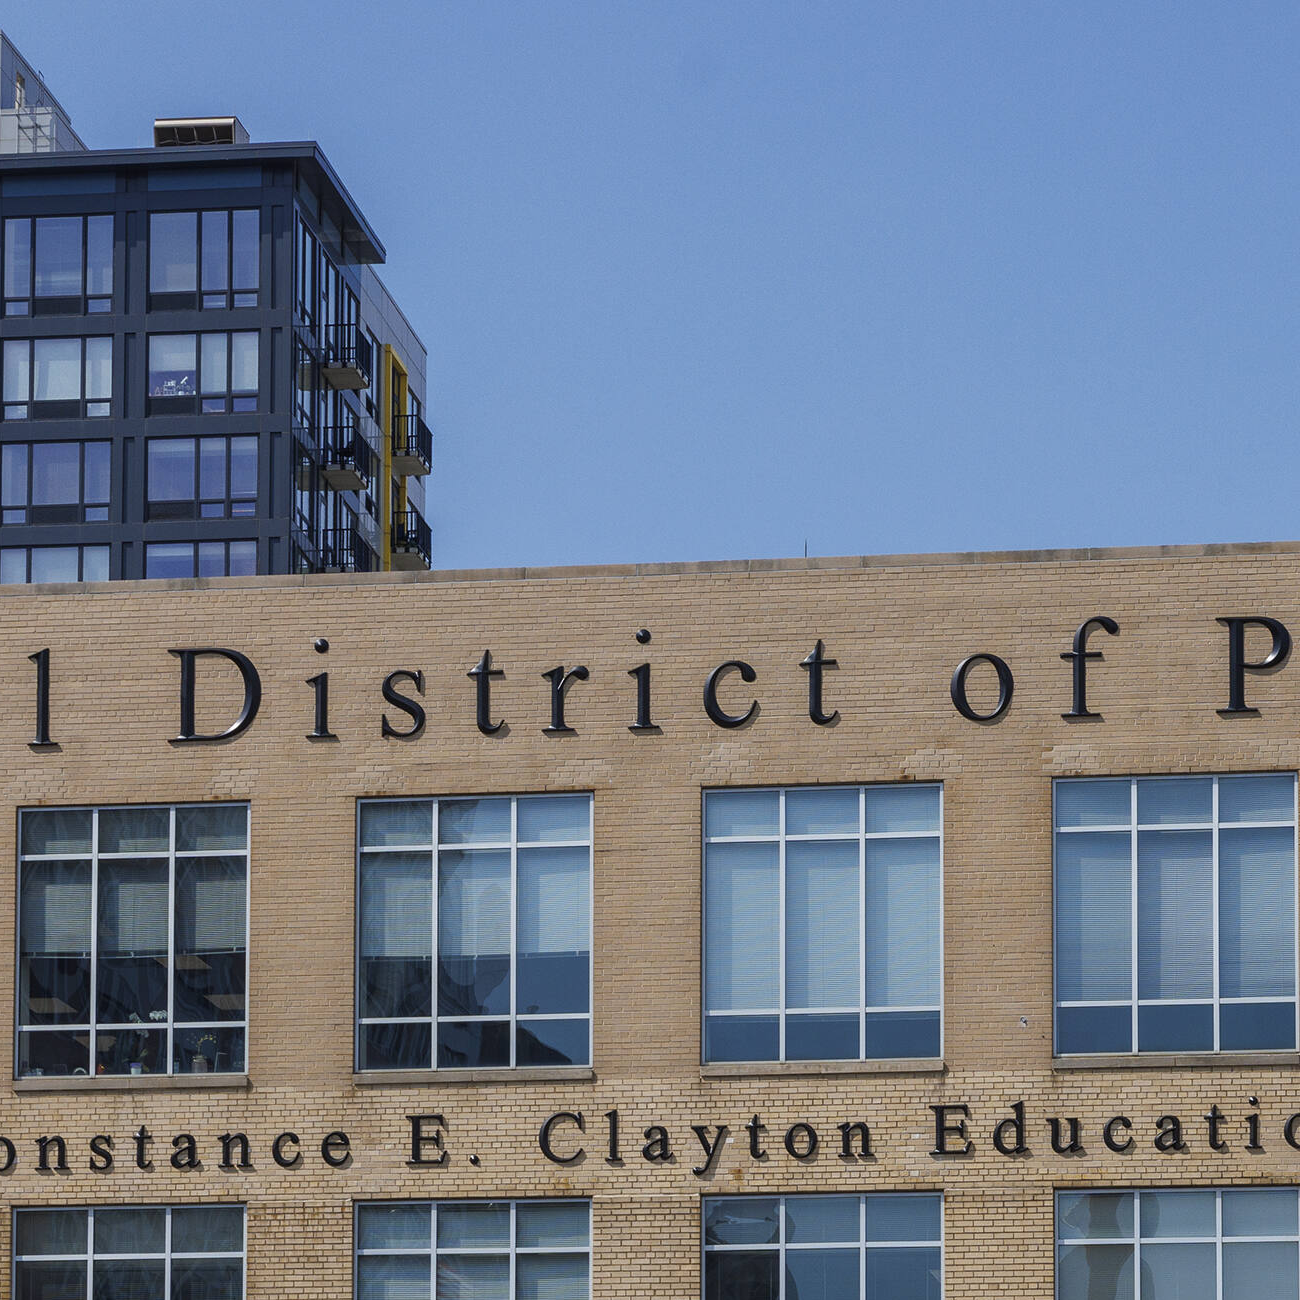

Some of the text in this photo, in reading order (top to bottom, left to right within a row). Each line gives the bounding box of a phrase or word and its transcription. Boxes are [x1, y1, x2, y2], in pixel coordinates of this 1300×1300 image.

[167, 630, 840, 745] District
[950, 616, 1119, 722] of
[406, 1114, 480, 1167] E.
[539, 1110, 876, 1177] Clayton
